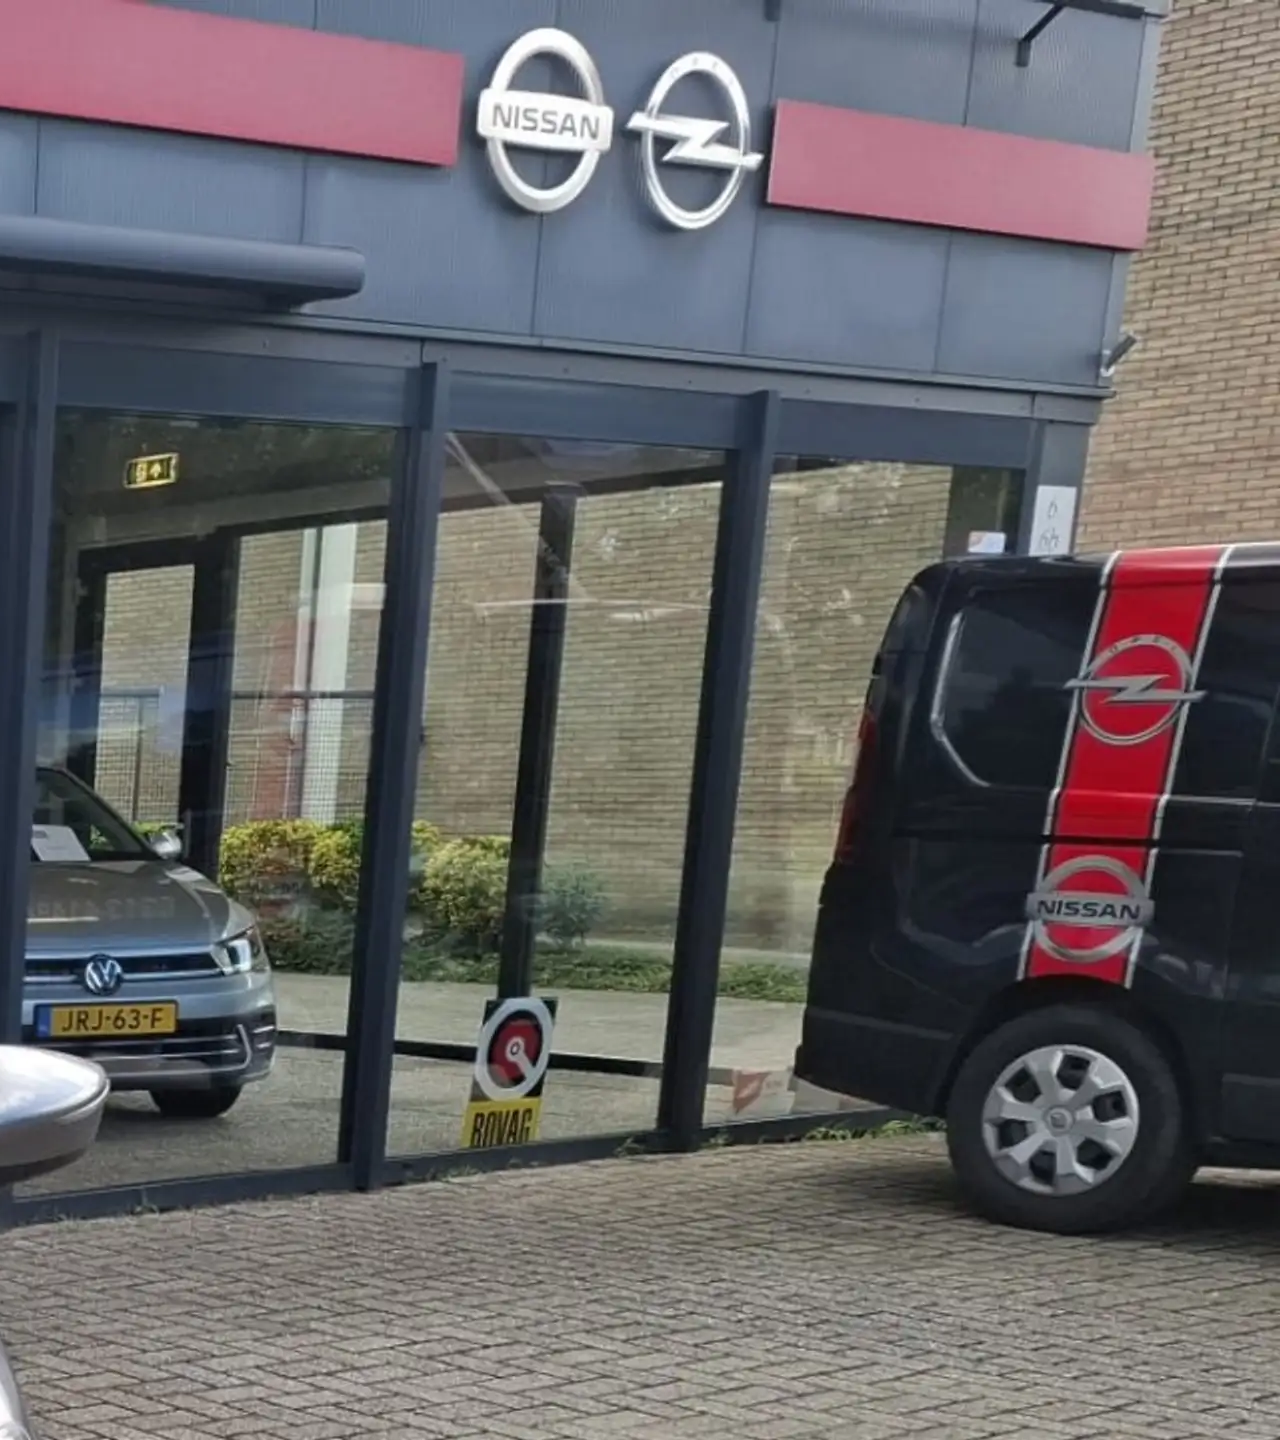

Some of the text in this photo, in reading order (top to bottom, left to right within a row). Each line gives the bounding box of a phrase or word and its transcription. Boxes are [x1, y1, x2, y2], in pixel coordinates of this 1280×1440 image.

[492, 104, 600, 140] NISSAN
[1038, 899, 1140, 920] NISSAN
[61, 1008, 164, 1032] JRJ-63-F
